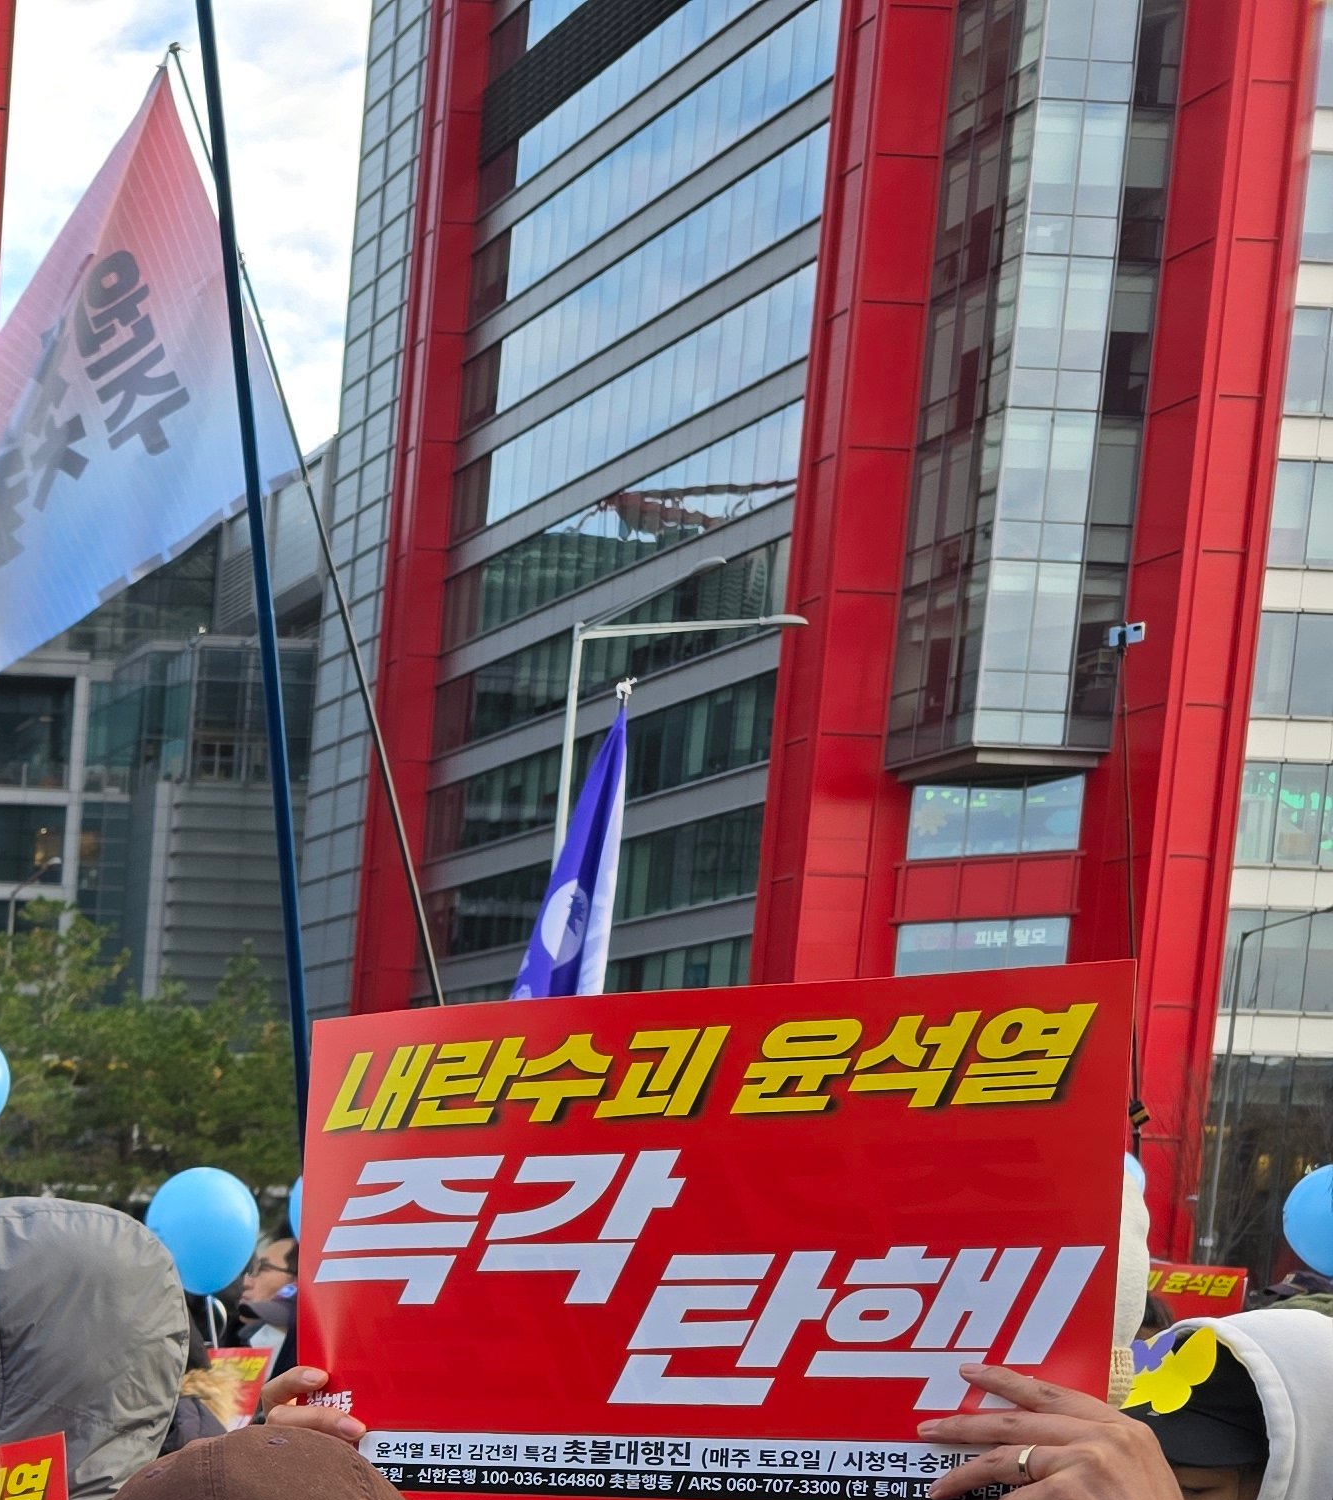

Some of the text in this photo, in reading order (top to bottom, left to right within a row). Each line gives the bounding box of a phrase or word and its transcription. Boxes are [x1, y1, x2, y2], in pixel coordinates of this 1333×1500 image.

[974, 929, 1008, 947] 피부
[1013, 927, 1046, 947] 탈모
[323, 1002, 1098, 1131] 내란수괴 윤석열
[314, 1149, 686, 1306] 즉각
[1161, 1271, 1239, 1297] 윤석열
[608, 1245, 1104, 1413] 탄핵!
[375, 1442, 424, 1459] 윤석열
[429, 1443, 462, 1460] 퇴진
[467, 1443, 518, 1462] 김건희
[523, 1445, 557, 1463] 특검
[562, 1439, 691, 1468] 촛불대행진
[701, 1448, 751, 1470] (매주
[756, 1449, 820, 1471] 토요일
[417, 1468, 476, 1485] 신한은행
[480, 1470, 605, 1488] 100-036-164860
[609, 1473, 672, 1491] 촛불행동
[688, 1476, 722, 1491] ARS
[726, 1477, 840, 1496] 060-707-3300
[845, 1479, 868, 1499] (한
[873, 1481, 907, 1498] 통에
